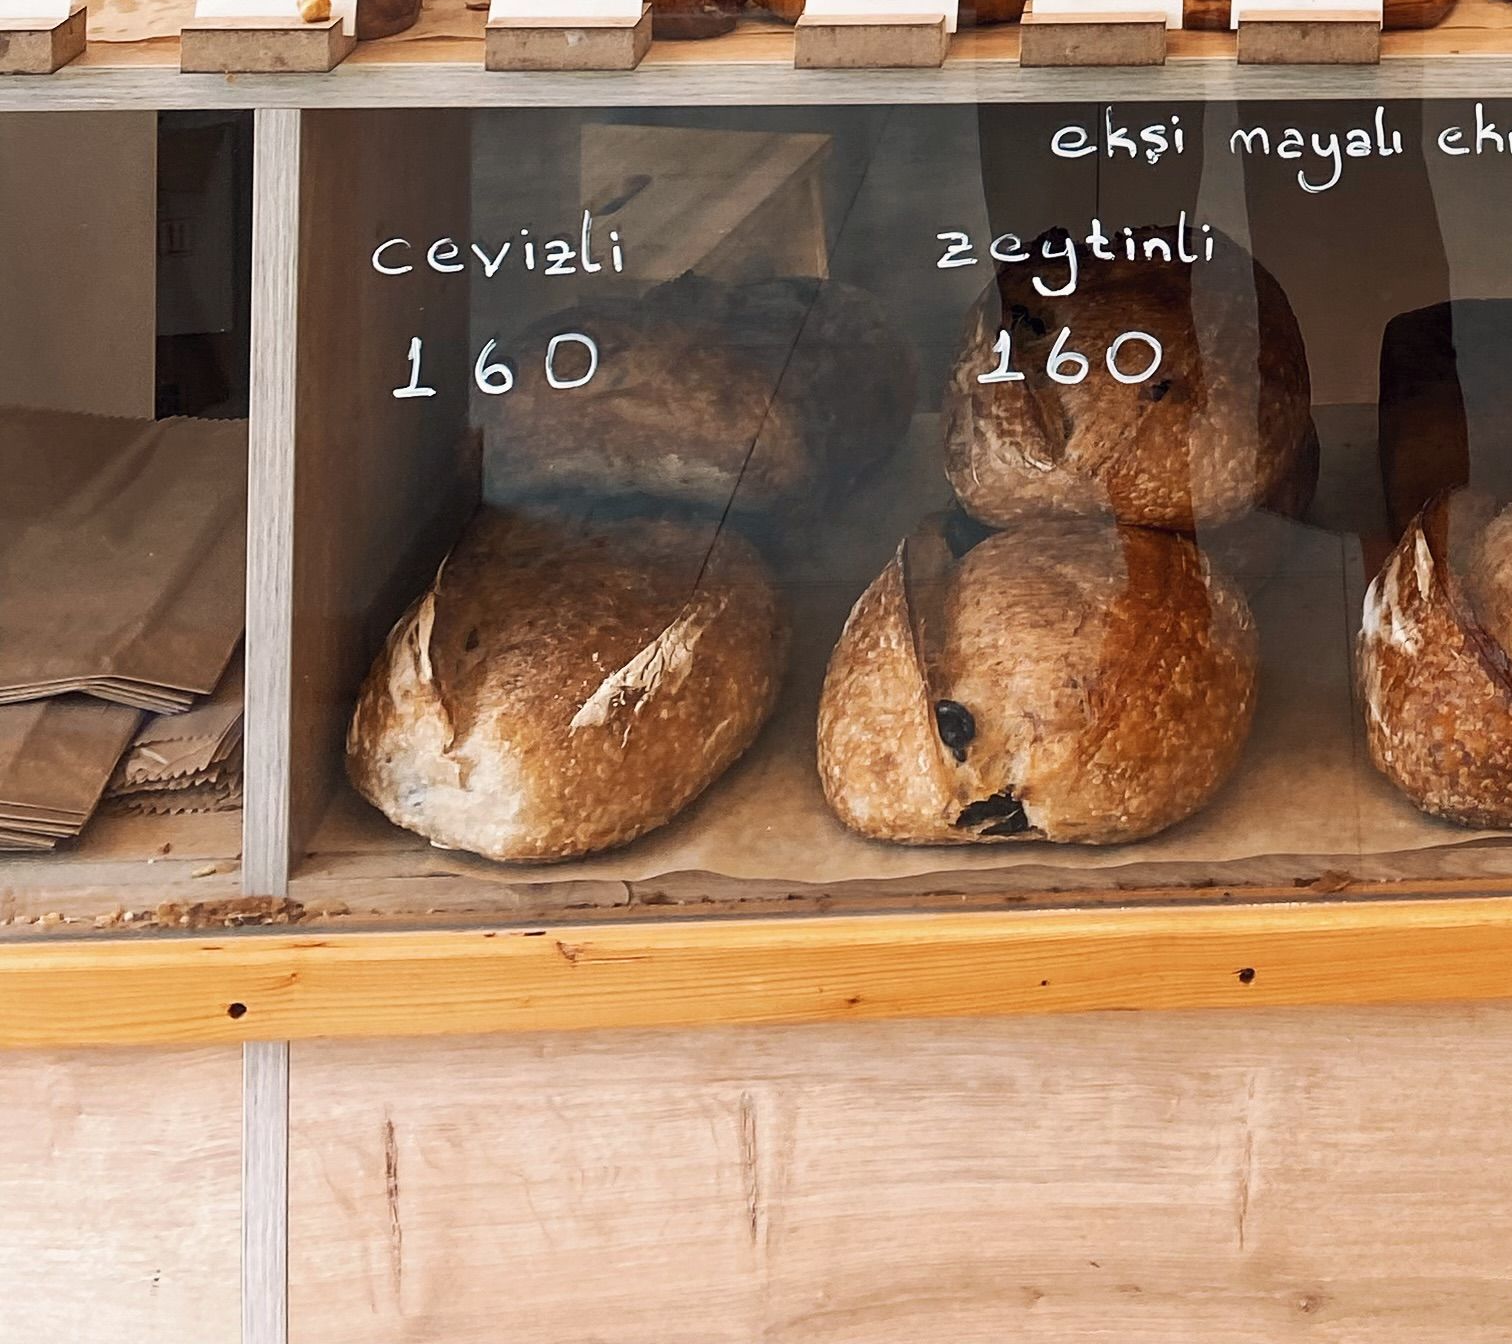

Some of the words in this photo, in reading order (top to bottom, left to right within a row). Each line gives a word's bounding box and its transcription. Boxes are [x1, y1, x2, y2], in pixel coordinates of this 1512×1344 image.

[1052, 106, 1186, 167] ekşi
[1228, 109, 1407, 196] mayalı
[370, 207, 627, 281] cevizli
[935, 220, 1218, 299] zeytinli
[391, 330, 600, 400] 160
[975, 328, 1164, 386] 160
